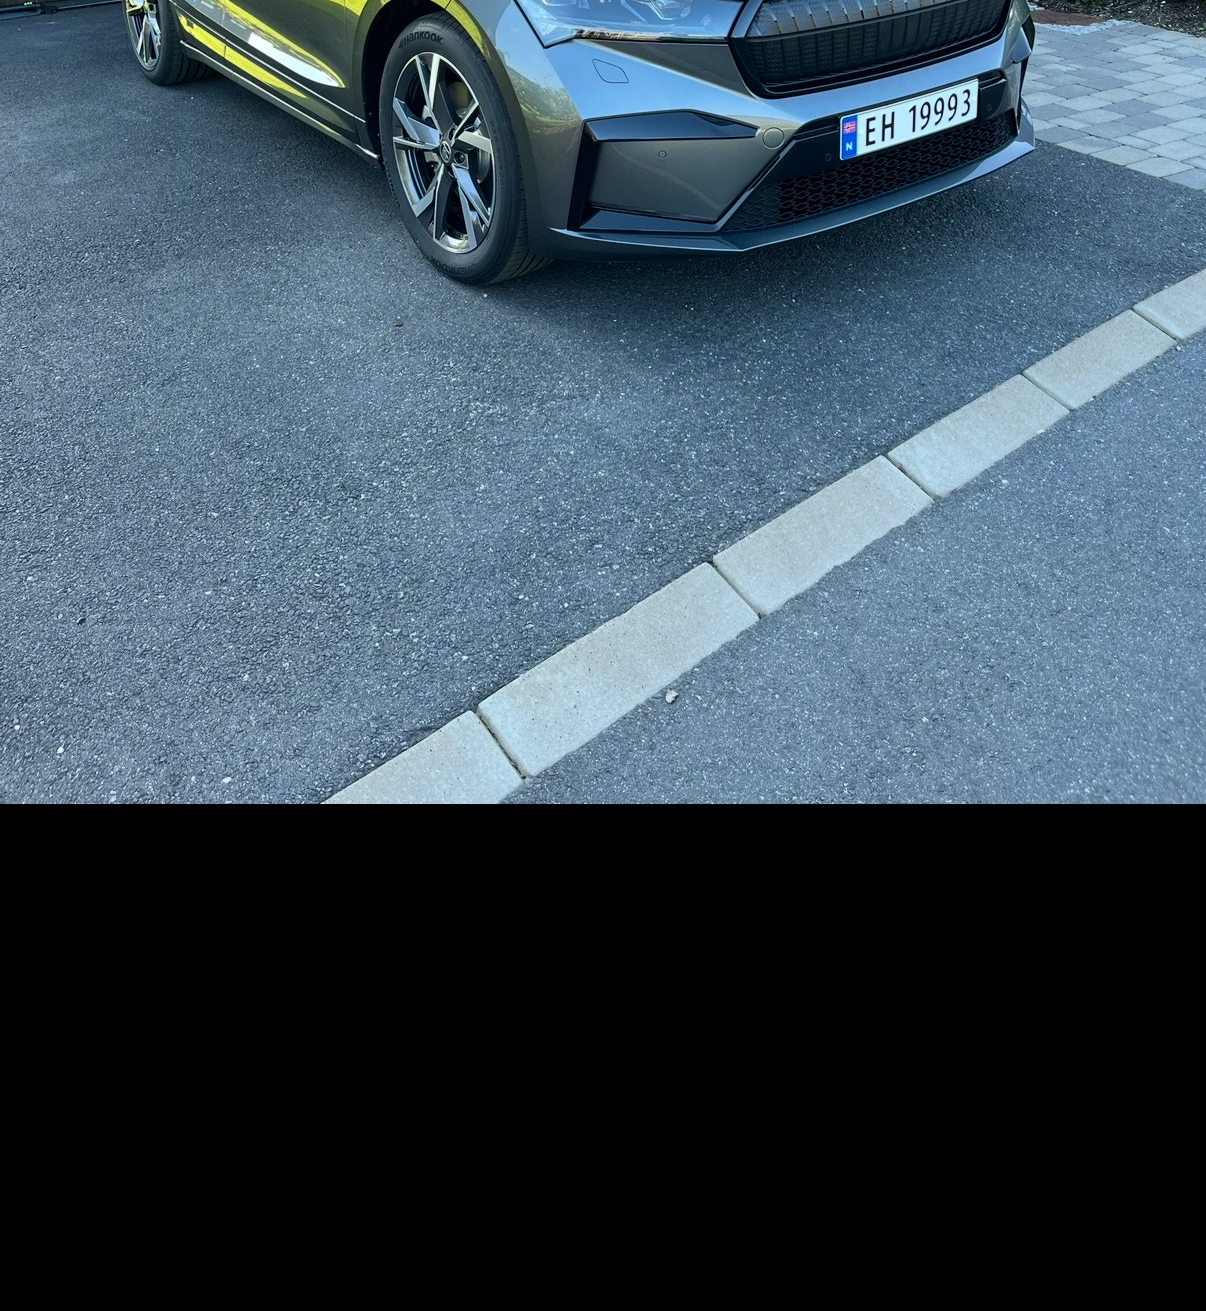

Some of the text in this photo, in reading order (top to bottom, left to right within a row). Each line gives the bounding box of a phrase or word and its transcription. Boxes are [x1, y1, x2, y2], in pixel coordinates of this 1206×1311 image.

[865, 88, 971, 147] EH 19993
[845, 141, 853, 152] N
